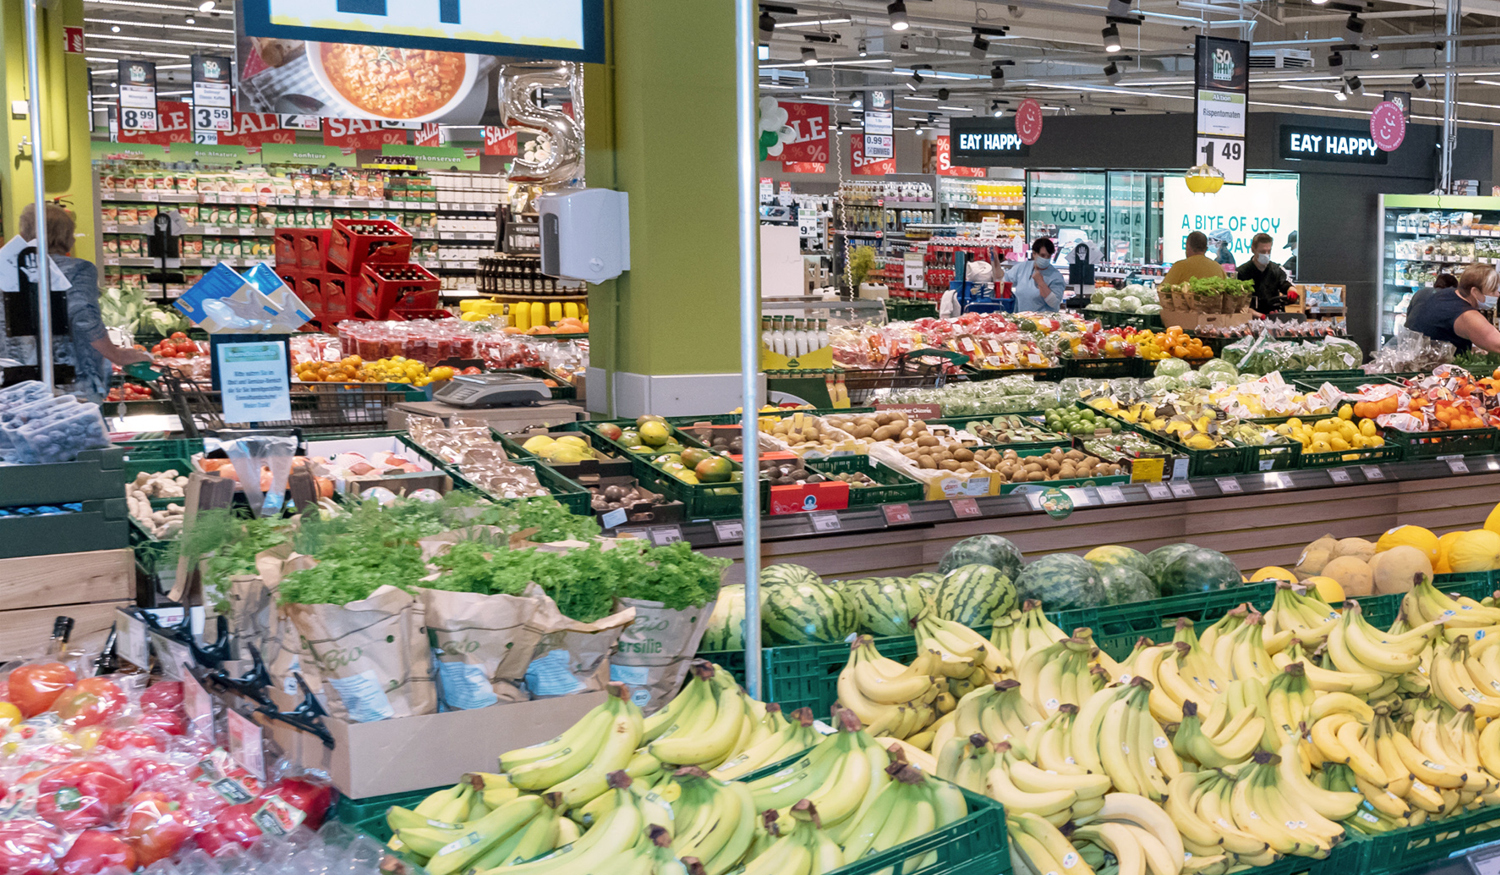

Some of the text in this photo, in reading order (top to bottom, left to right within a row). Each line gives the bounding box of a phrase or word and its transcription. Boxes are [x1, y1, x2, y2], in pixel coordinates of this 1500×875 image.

[1216, 49, 1231, 63] 50
[124, 110, 155, 129] 8.99
[197, 109, 229, 129] 3.59
[1203, 107, 1240, 119] Rispentomaten
[960, 133, 1023, 150] EAT HAPPY
[1290, 133, 1378, 156] EAT HAPPY
[1181, 214, 1280, 233] A BITE OF JOY
[907, 274, 924, 286] 1.99
[323, 646, 363, 671] Bio
